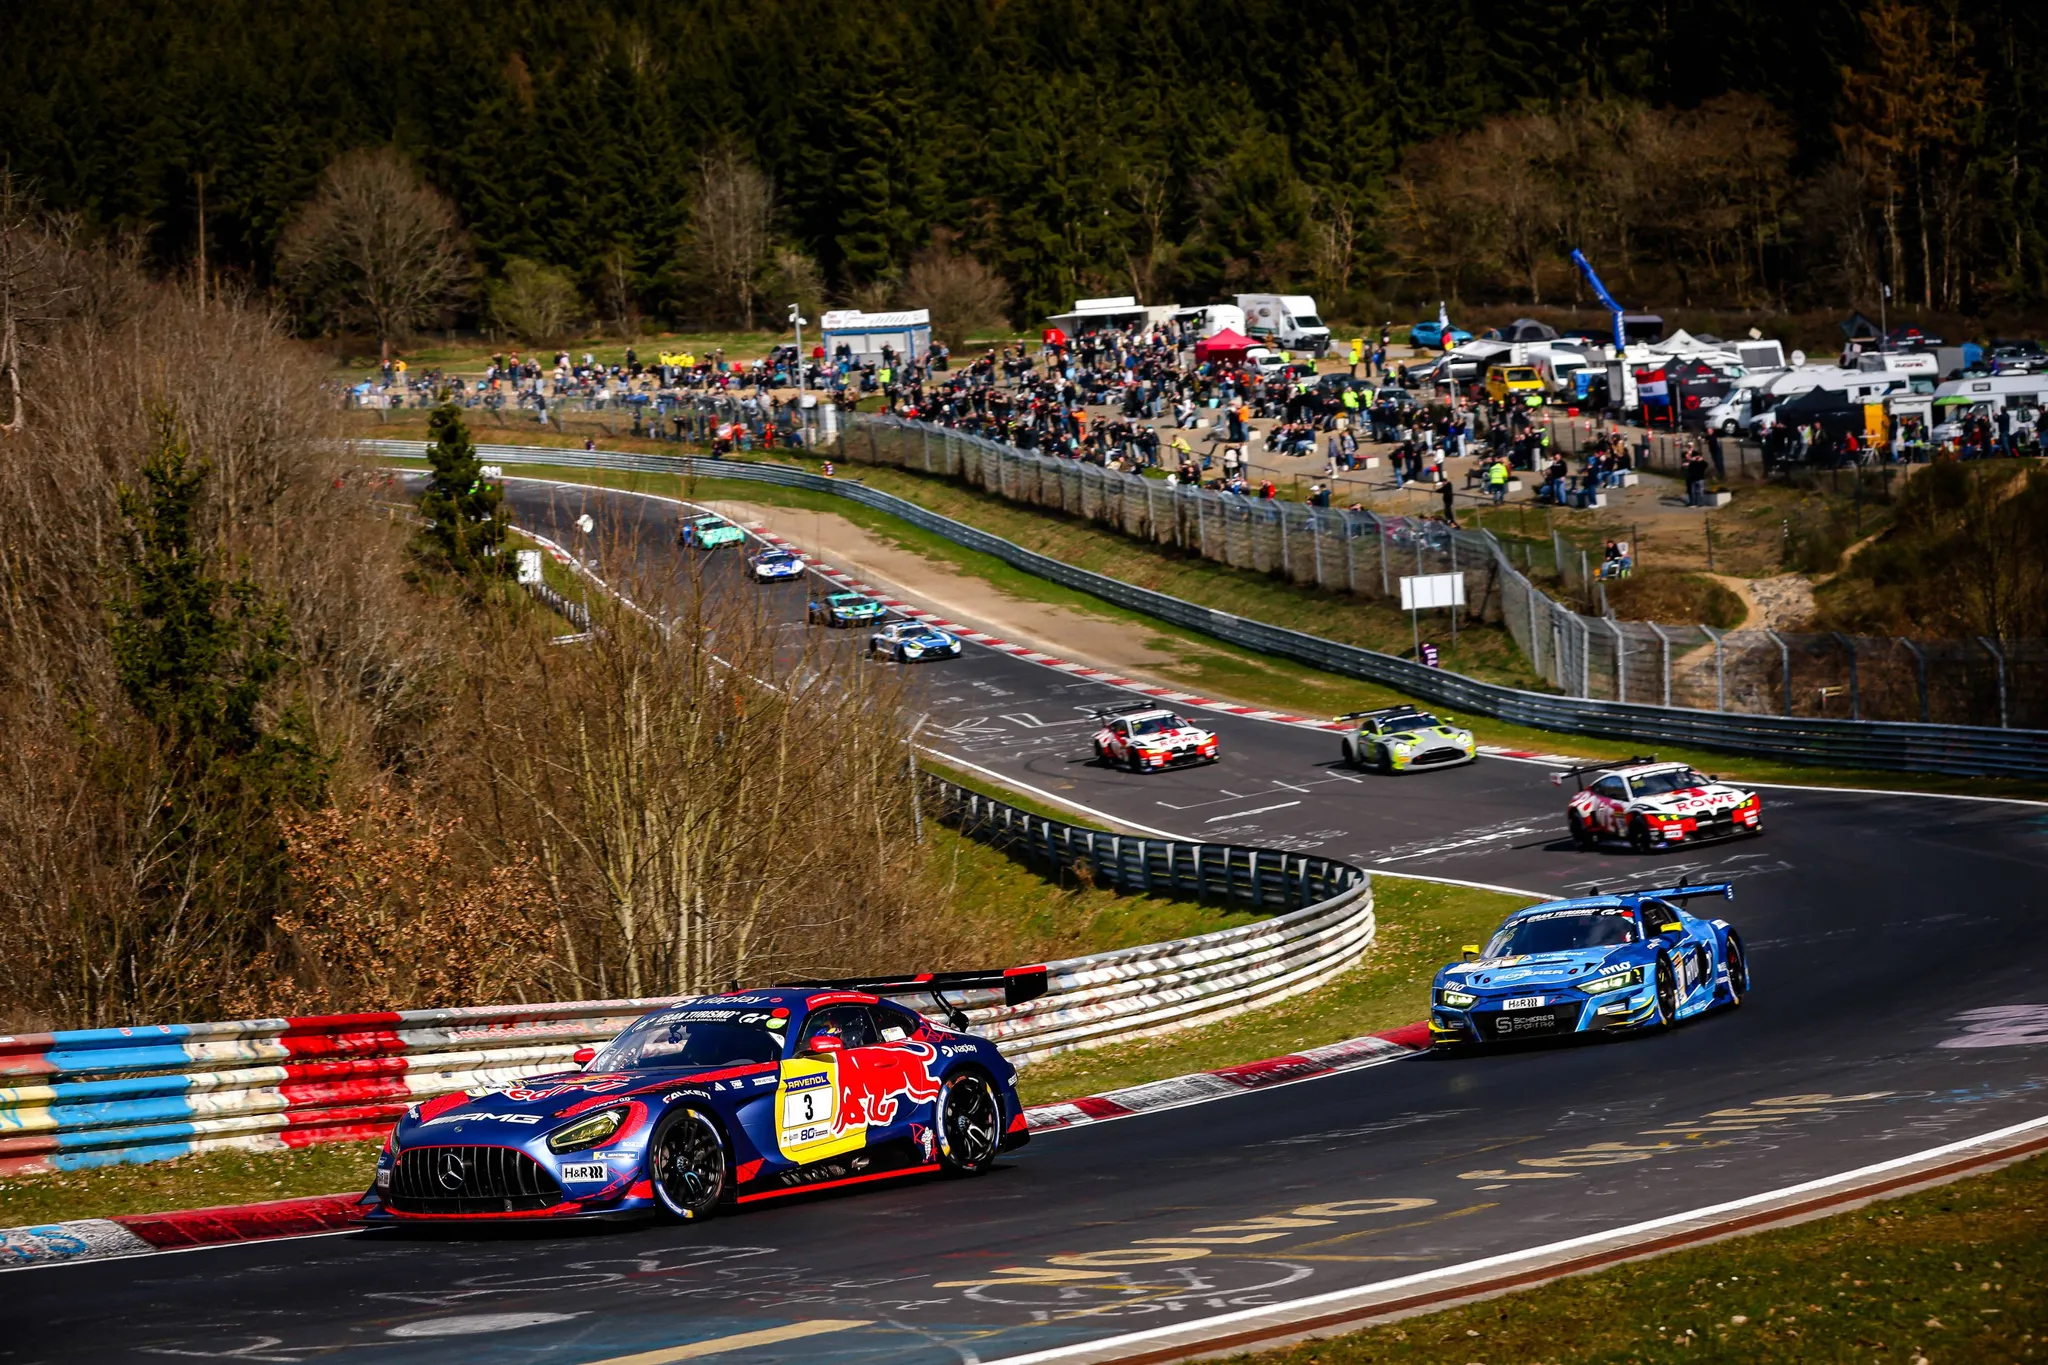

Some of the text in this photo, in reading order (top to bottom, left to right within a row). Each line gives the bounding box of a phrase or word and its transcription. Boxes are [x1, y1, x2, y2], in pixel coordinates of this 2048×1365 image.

[1160, 735, 1200, 747] ROWE
[1676, 795, 1735, 811] ROWE
[697, 996, 769, 1006] viaplay
[656, 1010, 735, 1023] GRAN TURISMO
[952, 1044, 978, 1053] viaplay
[788, 1076, 827, 1089] RAVENOL
[663, 1089, 711, 1104] FALKEN
[803, 1094, 814, 1120] 3
[457, 1113, 544, 1125] AMG
[565, 1167, 588, 1179] H&R
